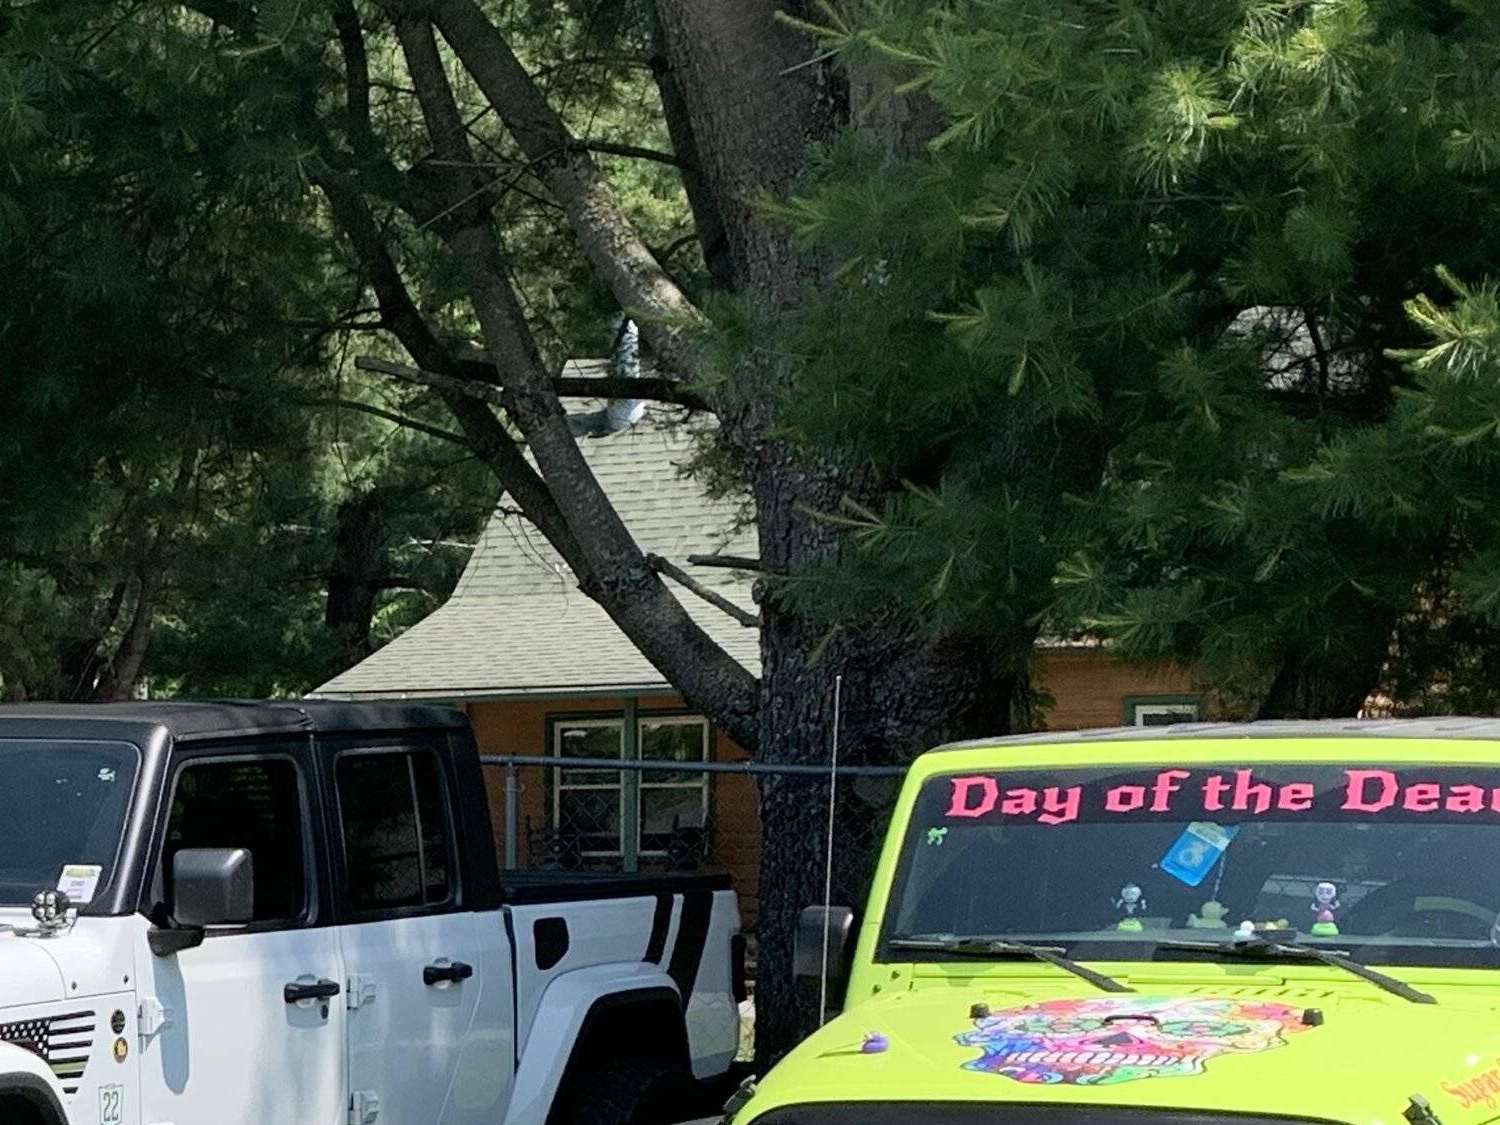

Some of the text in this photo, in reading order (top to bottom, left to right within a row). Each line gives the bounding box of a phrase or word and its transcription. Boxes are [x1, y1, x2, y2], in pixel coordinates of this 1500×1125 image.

[945, 776, 1082, 825] Day
[1105, 769, 1191, 812] of
[1202, 768, 1314, 814] the
[103, 1091, 119, 1122] 22
